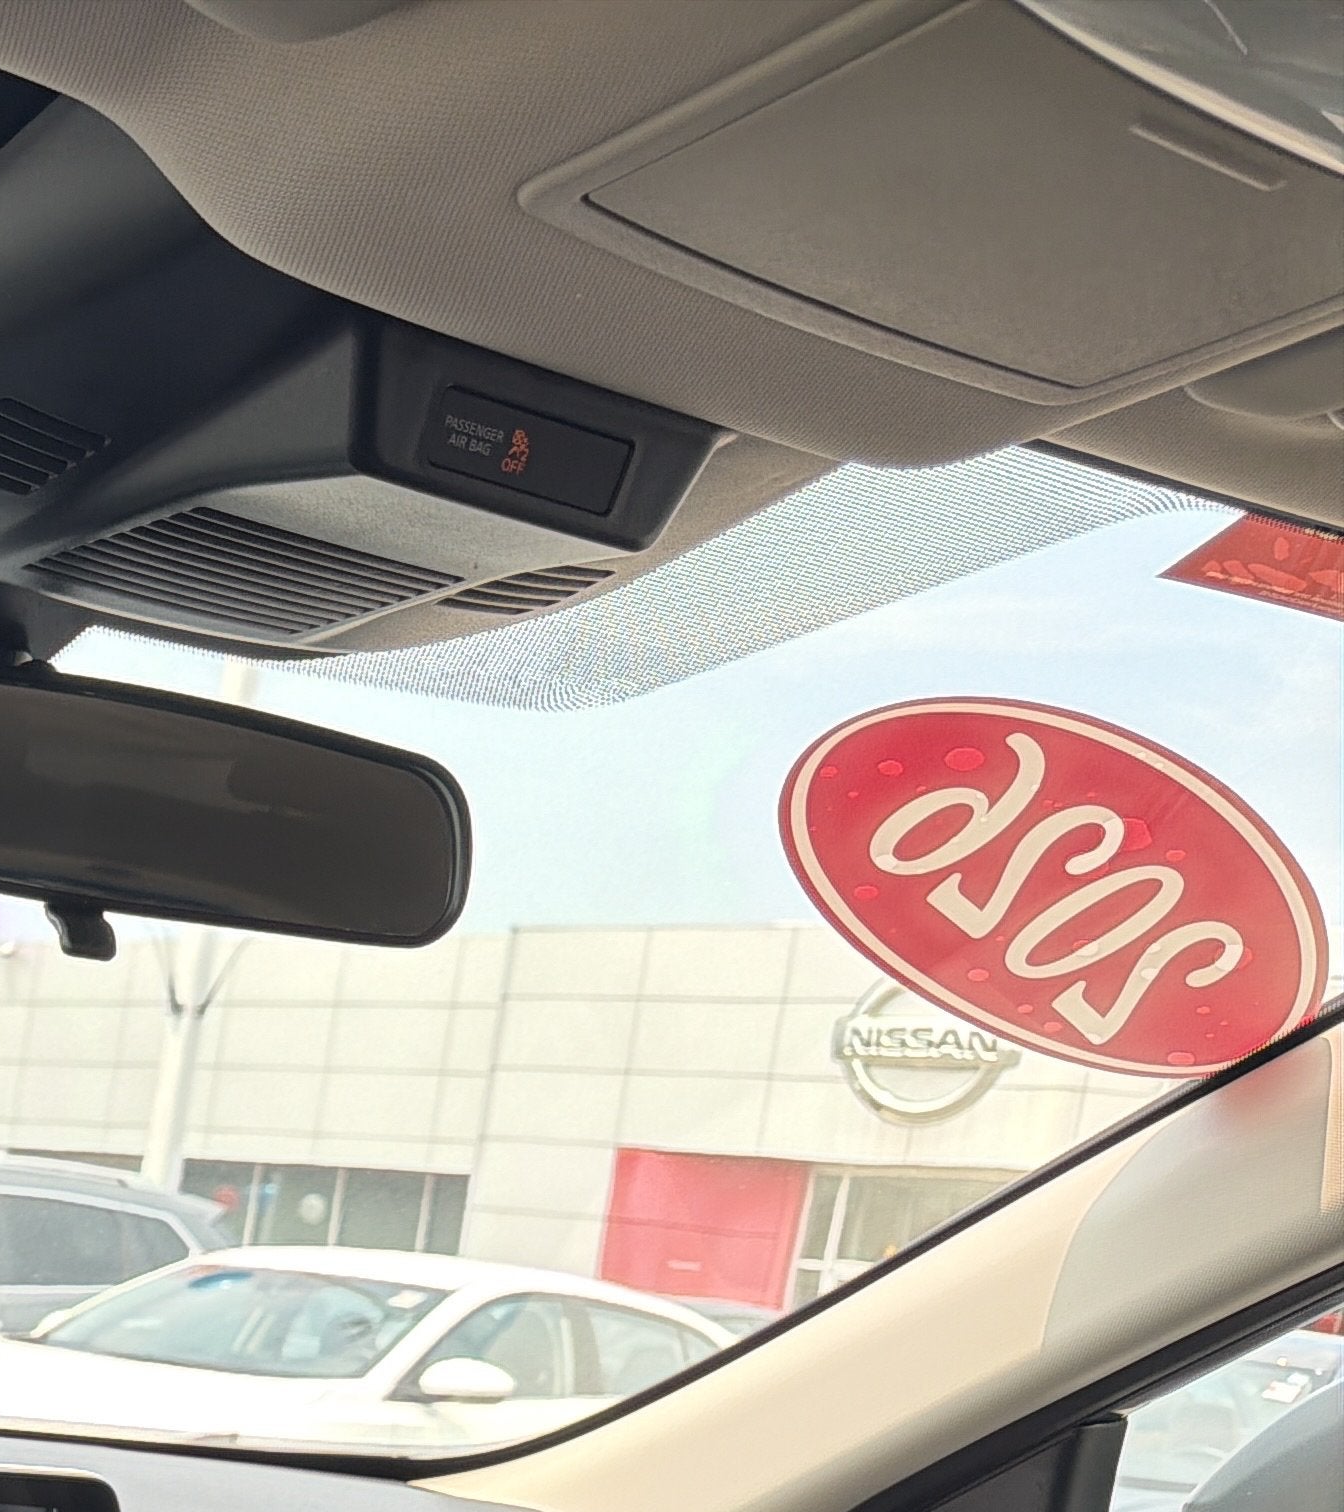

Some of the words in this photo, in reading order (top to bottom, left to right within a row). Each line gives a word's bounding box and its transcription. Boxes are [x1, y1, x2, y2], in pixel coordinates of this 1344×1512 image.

[444, 414, 505, 443] PASSENGER
[448, 433, 468, 449] AIR
[468, 439, 492, 456] BAG
[500, 458, 526, 476] OFF
[845, 1026, 999, 1062] NISSAN
